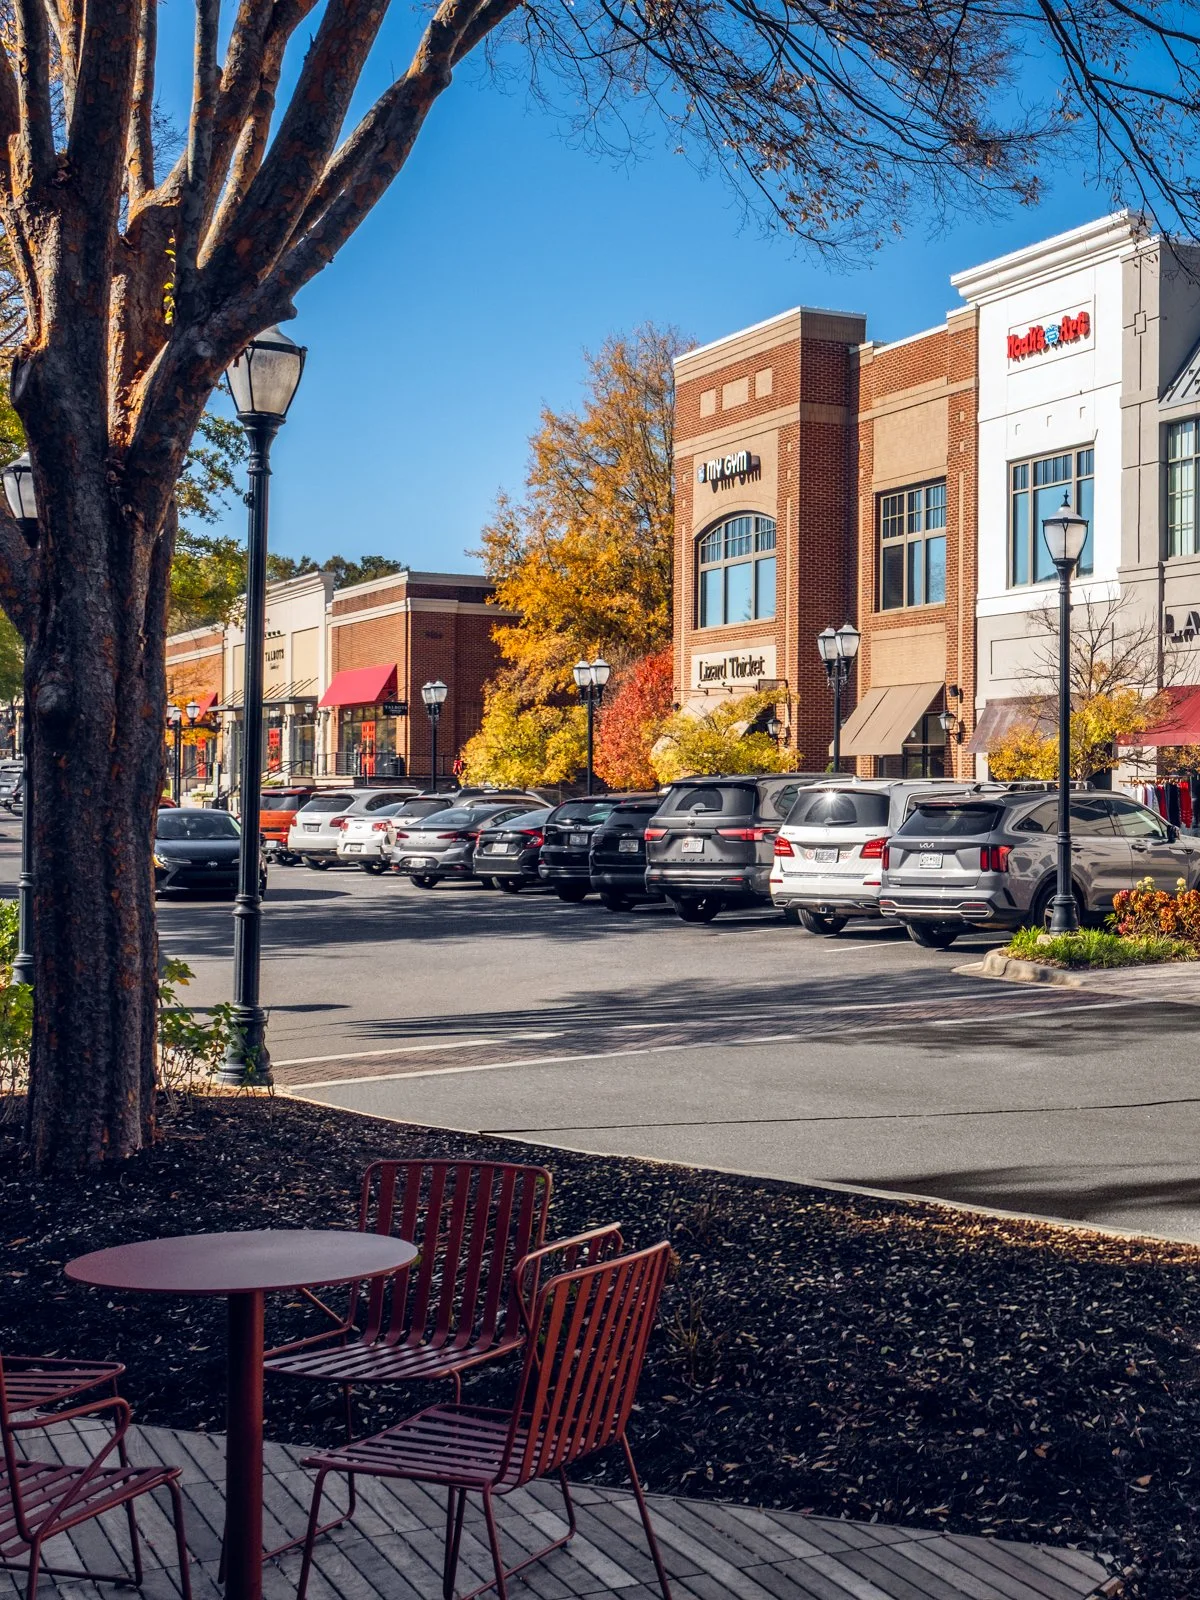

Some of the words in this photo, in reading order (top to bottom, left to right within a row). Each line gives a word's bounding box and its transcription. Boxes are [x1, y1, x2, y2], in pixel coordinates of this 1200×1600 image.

[706, 458, 723, 481] MY
[724, 450, 750, 476] GYM
[265, 649, 285, 662] TALBOTS
[699, 658, 727, 682] Lizard
[729, 655, 766, 678] Thicket
